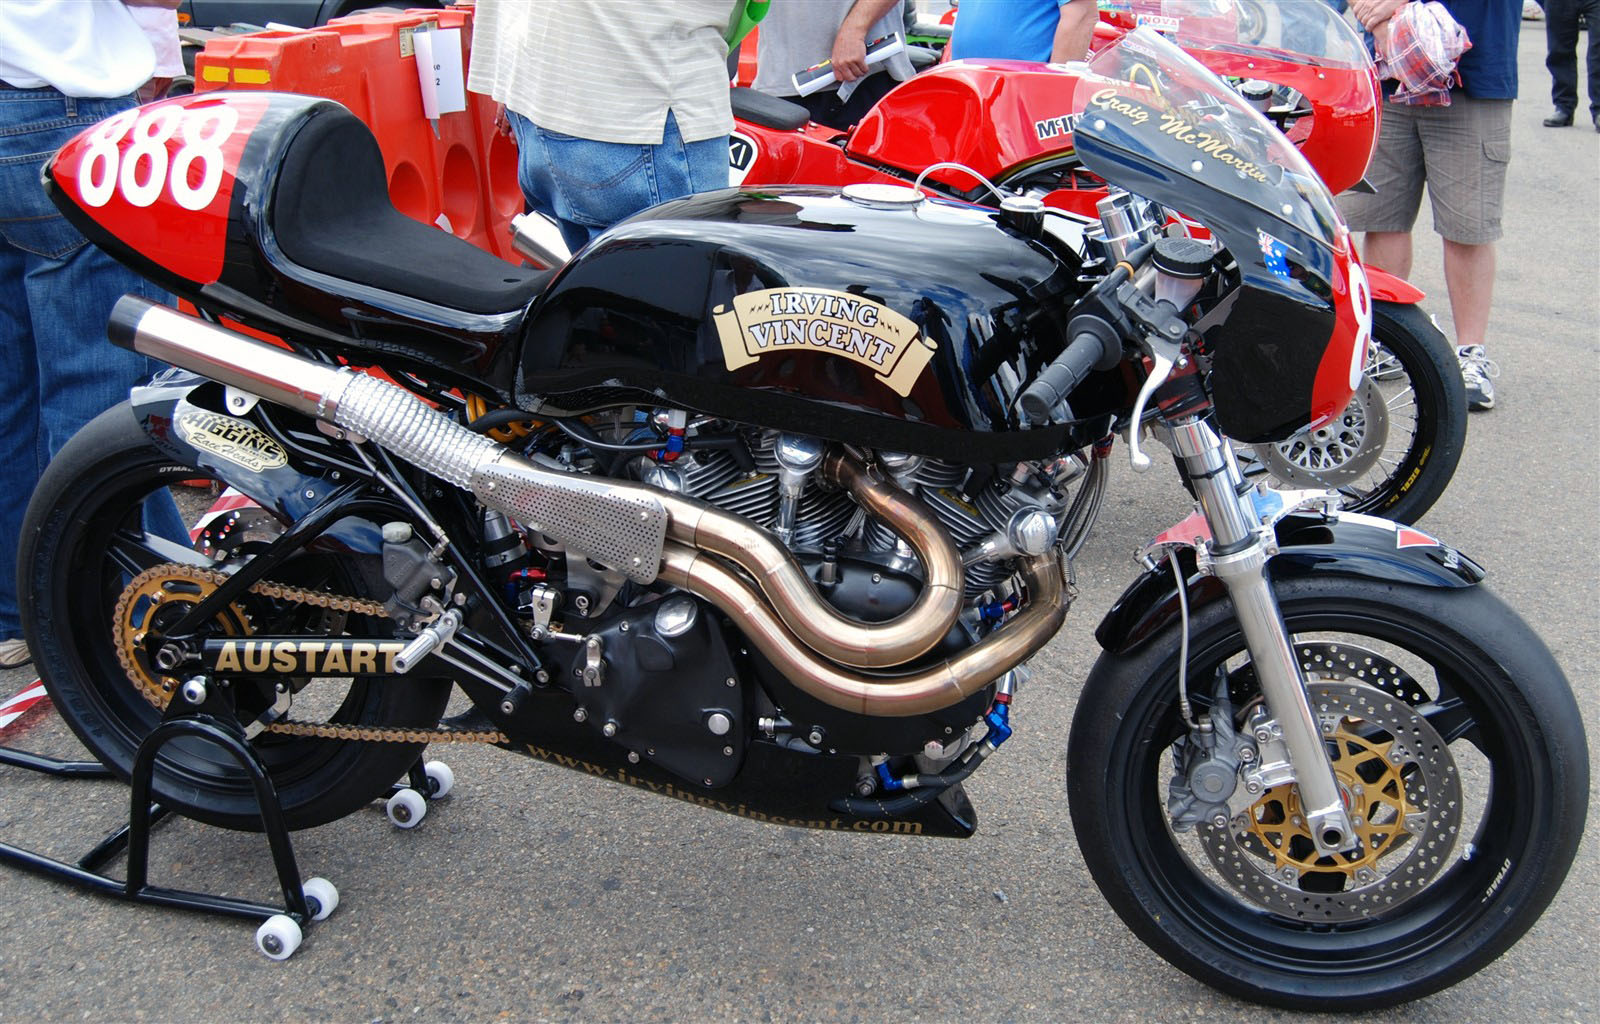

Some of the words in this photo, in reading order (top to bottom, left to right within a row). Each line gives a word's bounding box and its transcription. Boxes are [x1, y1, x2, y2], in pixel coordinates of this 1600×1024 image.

[1143, 16, 1177, 26] NOVA
[1091, 88, 1149, 126] Craig
[79, 105, 239, 211] 888
[769, 292, 880, 328] IRVING
[748, 318, 896, 366] VINCENT
[215, 641, 405, 674] AUSTART
